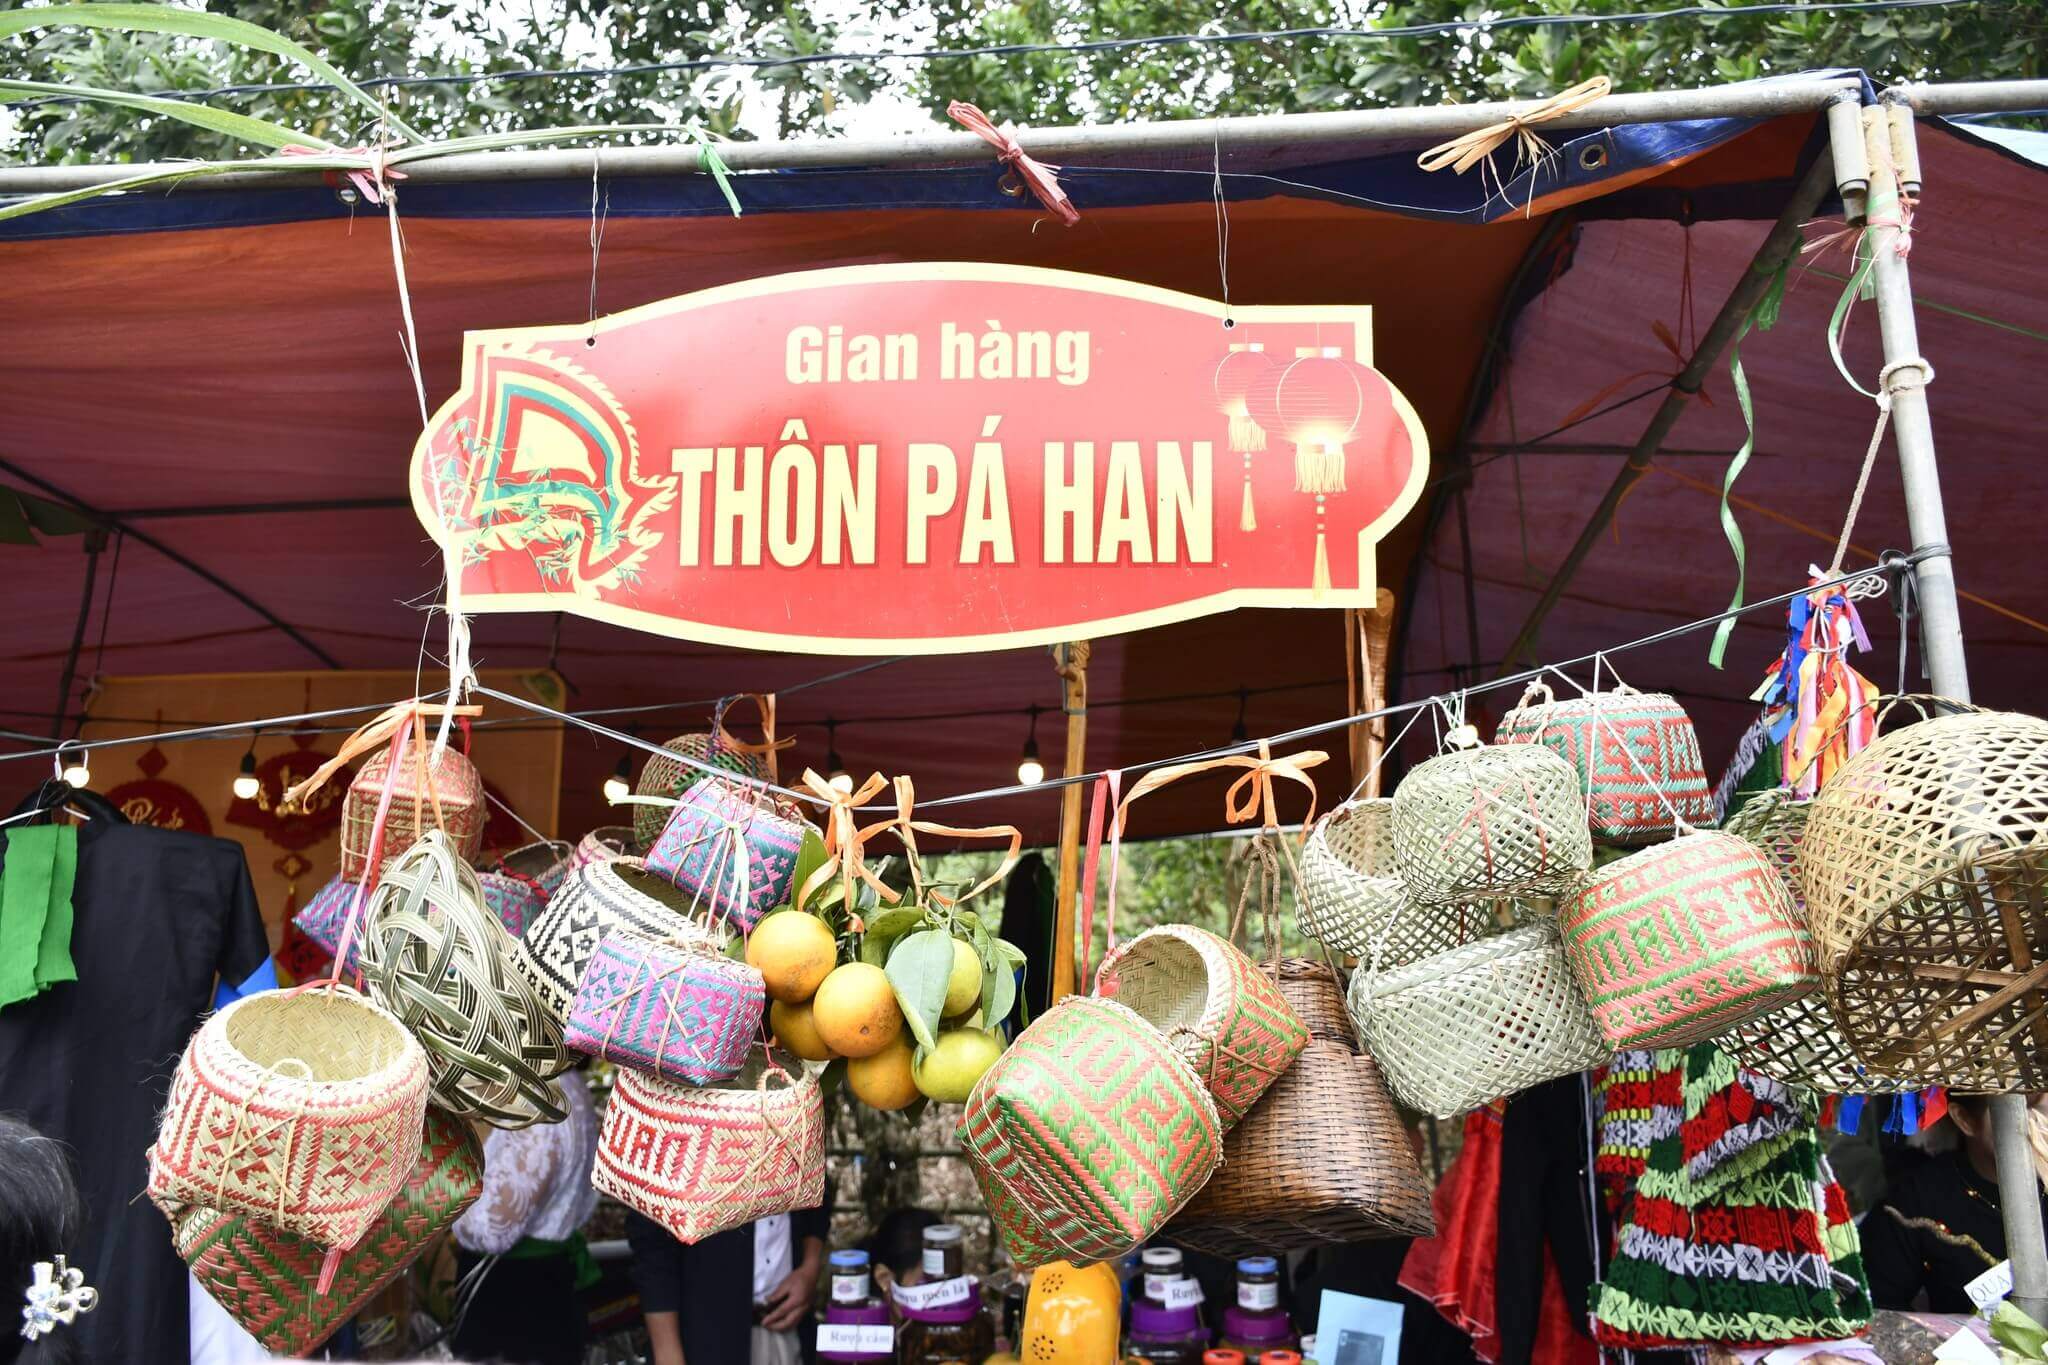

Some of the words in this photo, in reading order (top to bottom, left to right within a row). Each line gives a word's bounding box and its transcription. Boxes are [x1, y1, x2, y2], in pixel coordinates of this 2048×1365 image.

[784, 324, 920, 385] Gian
[940, 319, 1091, 388] hàng
[671, 418, 878, 568] THÔN
[906, 414, 1016, 566] PÁ
[1043, 440, 1215, 565] HAN
